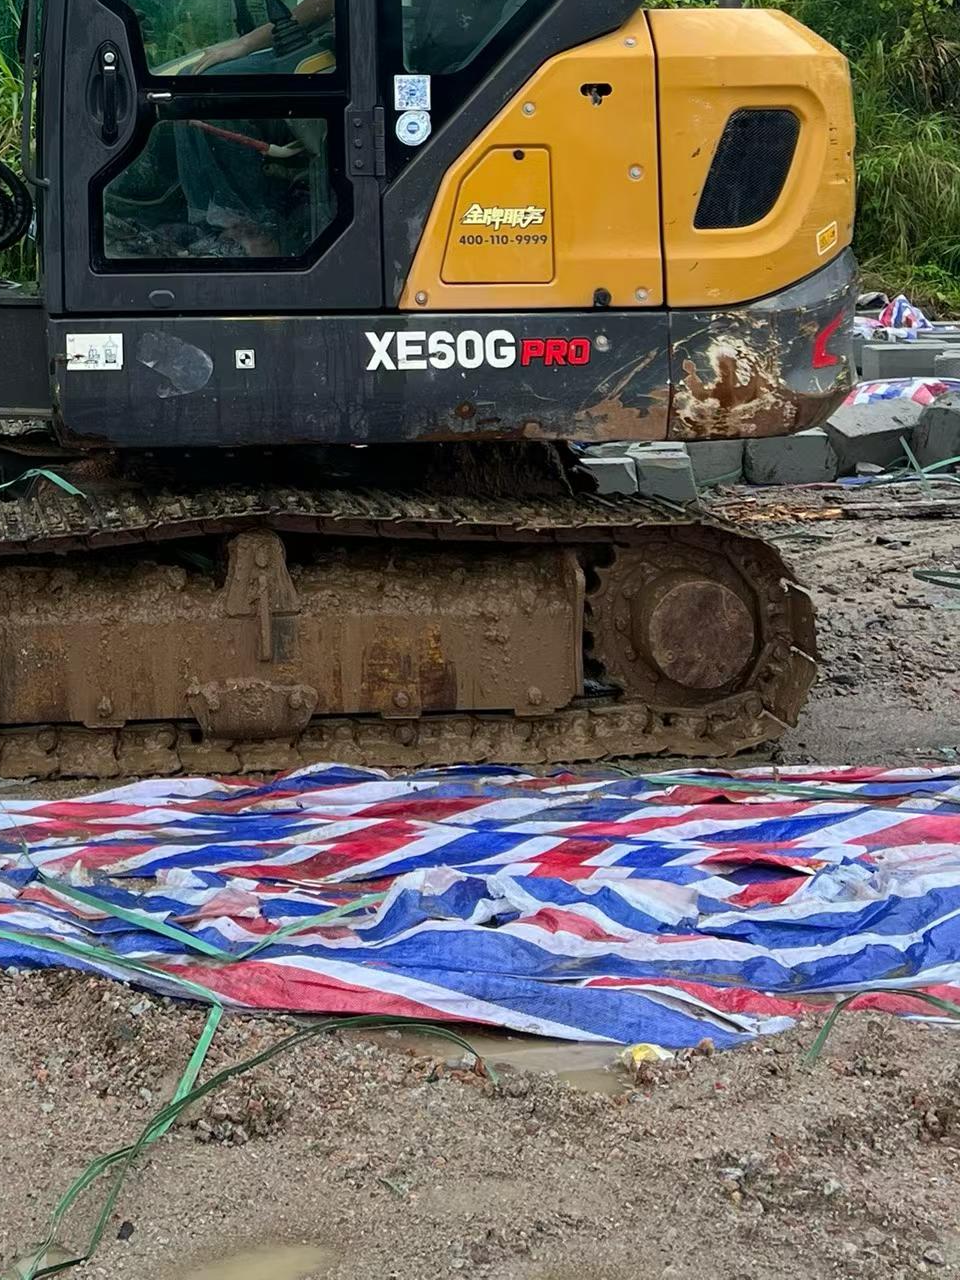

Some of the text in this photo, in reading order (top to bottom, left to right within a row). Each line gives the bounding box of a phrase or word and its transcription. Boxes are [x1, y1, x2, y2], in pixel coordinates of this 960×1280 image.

[460, 203, 546, 231] 金牌服务
[459, 234, 548, 246] 400-110-9999
[364, 329, 592, 371] XE60G PRO
